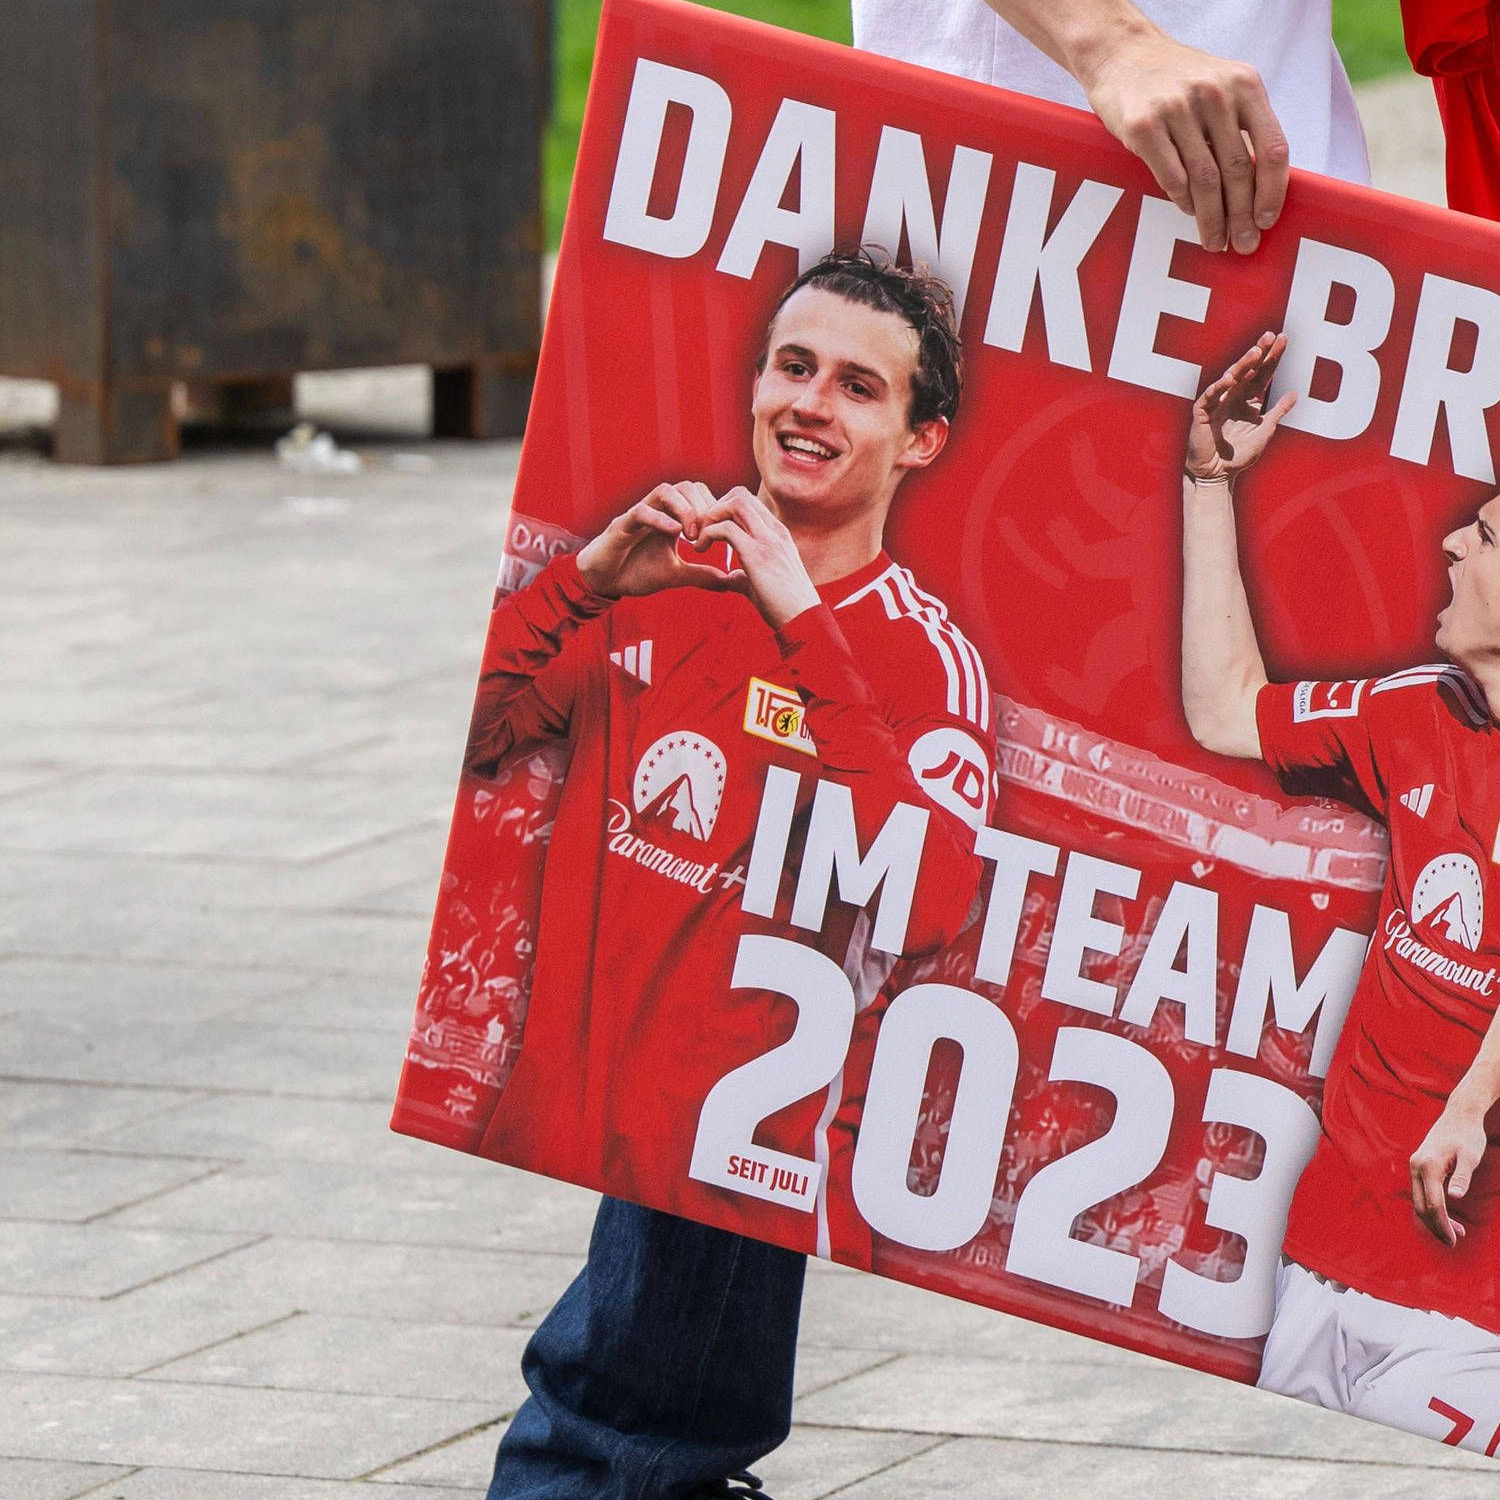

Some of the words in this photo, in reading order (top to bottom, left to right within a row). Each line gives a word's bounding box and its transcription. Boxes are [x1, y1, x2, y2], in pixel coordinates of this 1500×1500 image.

[602, 56, 1213, 400] DANKE
[740, 764, 930, 957] IM
[972, 824, 1370, 1077] TEAM
[688, 933, 1322, 1340] 2023
[727, 1154, 769, 1183] SEIT
[769, 1167, 809, 1196] JULI
